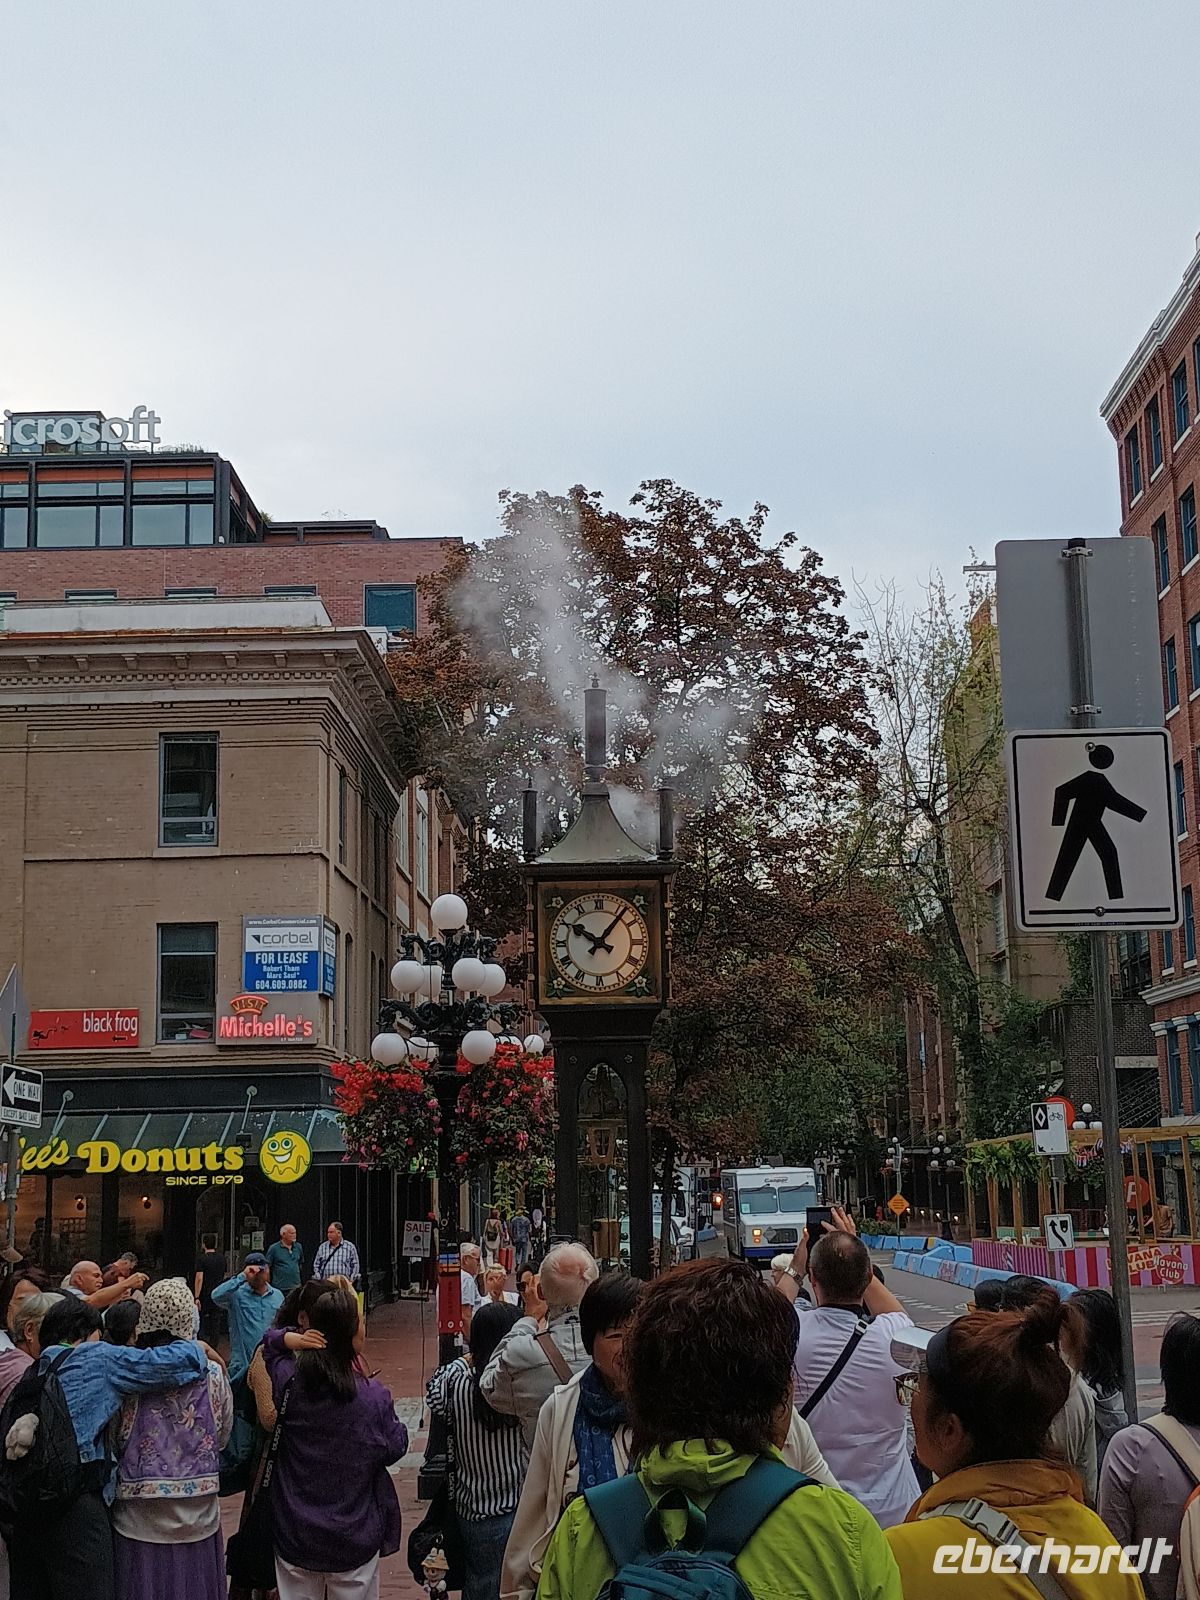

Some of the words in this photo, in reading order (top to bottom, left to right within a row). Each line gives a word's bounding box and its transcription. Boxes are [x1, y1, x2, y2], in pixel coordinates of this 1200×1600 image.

[3, 405, 161, 445] icrosoft
[262, 931, 313, 945] corbel
[255, 952, 275, 965] FOR
[277, 952, 309, 964] LEASE
[266, 971, 282, 979] Marc
[232, 999, 267, 1012] VISIT
[82, 1011, 113, 1033] black
[114, 1011, 138, 1037] frog
[219, 1013, 313, 1038] Michelle's
[13, 1081, 26, 1097] ONE
[28, 1084, 40, 1100] WAY
[19, 1137, 70, 1171] ee's
[77, 1141, 244, 1174] Donuts
[166, 1176, 207, 1186] SINCE
[212, 1175, 244, 1185] 1979
[405, 1223, 431, 1232] SALE
[1127, 1248, 1162, 1264] VANA
[1153, 1256, 1188, 1271] Havana
[1160, 1267, 1180, 1279] Club
